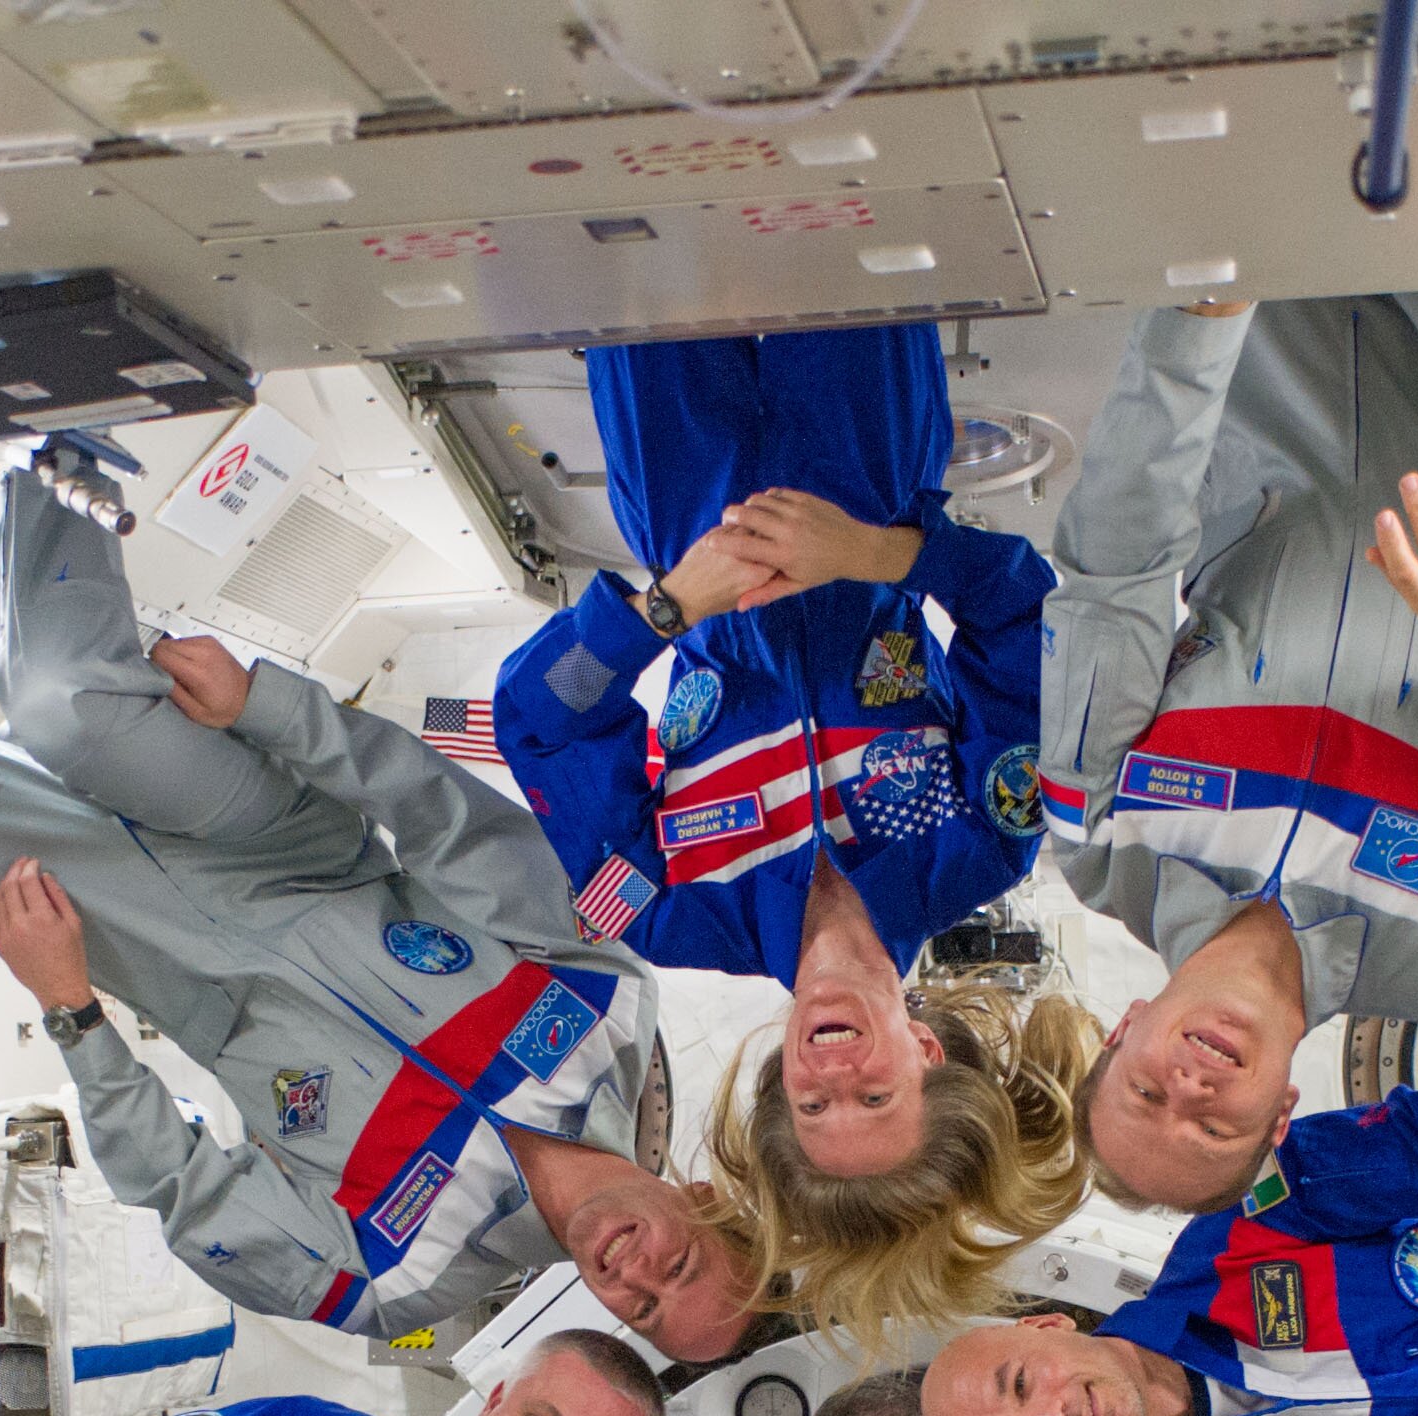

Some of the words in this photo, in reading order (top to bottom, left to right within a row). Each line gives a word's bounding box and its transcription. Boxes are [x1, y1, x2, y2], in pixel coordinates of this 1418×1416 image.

[235, 469, 259, 491] GOLD
[220, 491, 247, 515] AWARD
[865, 755, 926, 776] NASA
[1149, 766, 1190, 784] KOTOV
[673, 807, 723, 828] НАЙБЕРГ
[677, 820, 721, 839] NYBERG
[506, 984, 562, 1051] РОСКОСМОС
[1285, 1272, 1296, 1315] PARMITANO
[1290, 1316, 1299, 1336] LUCA
